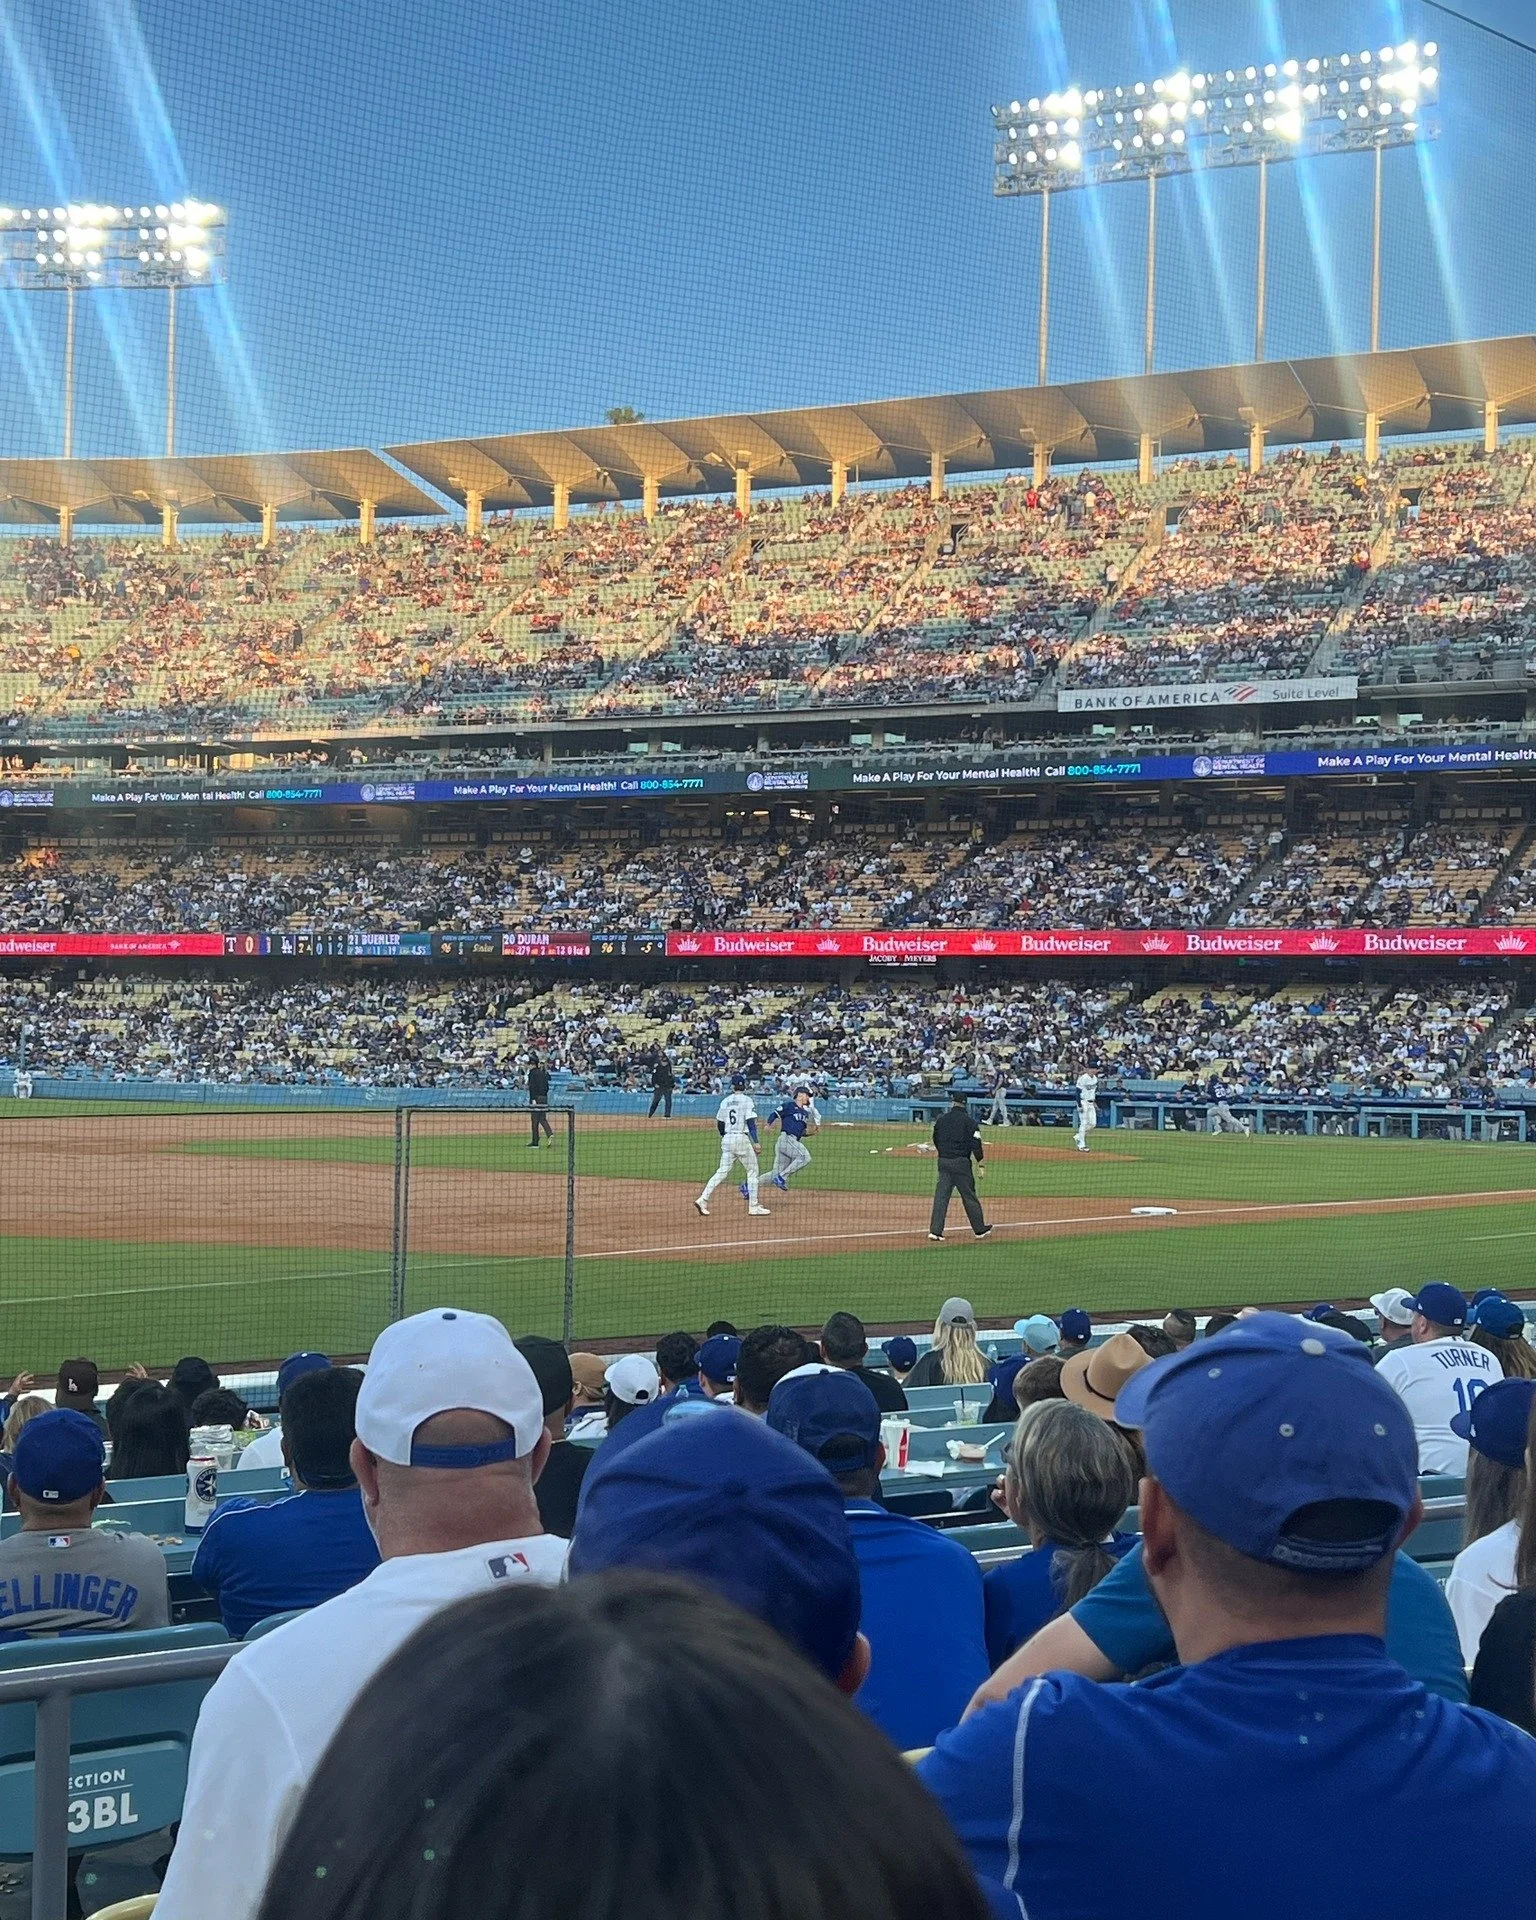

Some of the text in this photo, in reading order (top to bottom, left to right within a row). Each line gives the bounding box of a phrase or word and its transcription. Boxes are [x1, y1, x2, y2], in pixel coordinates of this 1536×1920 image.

[1075, 691, 1220, 709] BANK OF AMERICA
[1272, 686, 1339, 700] Suite Level
[1318, 749, 1536, 768] Make A Play For Your Mental Health
[853, 763, 1141, 783] Make A Play For Your Mental Health! Call 800-854-7771
[453, 778, 703, 796] Make A Play For Your Mental Health! Call 800-854-7771
[91, 793, 116, 802] Make
[117, 793, 124, 801] A
[125, 792, 143, 803] Play
[144, 792, 158, 801] For
[160, 792, 180, 801] Your
[215, 790, 245, 800] Health!
[248, 790, 264, 799] Call
[266, 789, 322, 799] 800-854-7771
[0, 938, 57, 953] udweiser
[226, 936, 237, 953] T
[245, 936, 254, 953] 0
[266, 936, 271, 953] 1
[281, 936, 292, 953] LA
[348, 934, 400, 945] 21 BUEHLER
[504, 934, 549, 945] 20 DURAN
[714, 936, 795, 953] Budweiser
[862, 936, 948, 952] Budweiser
[1020, 935, 1111, 952] Budweiser
[1186, 934, 1282, 951] Budweiser
[1364, 933, 1467, 951] Budweiser
[316, 943, 323, 955] 0
[328, 942, 333, 955] 1
[337, 942, 344, 955] 2
[729, 1109, 737, 1125] 6
[1431, 1349, 1490, 1372] TURNER
[0, 1573, 138, 1622] ELLINGER
[67, 1792, 139, 1834] 3BL
